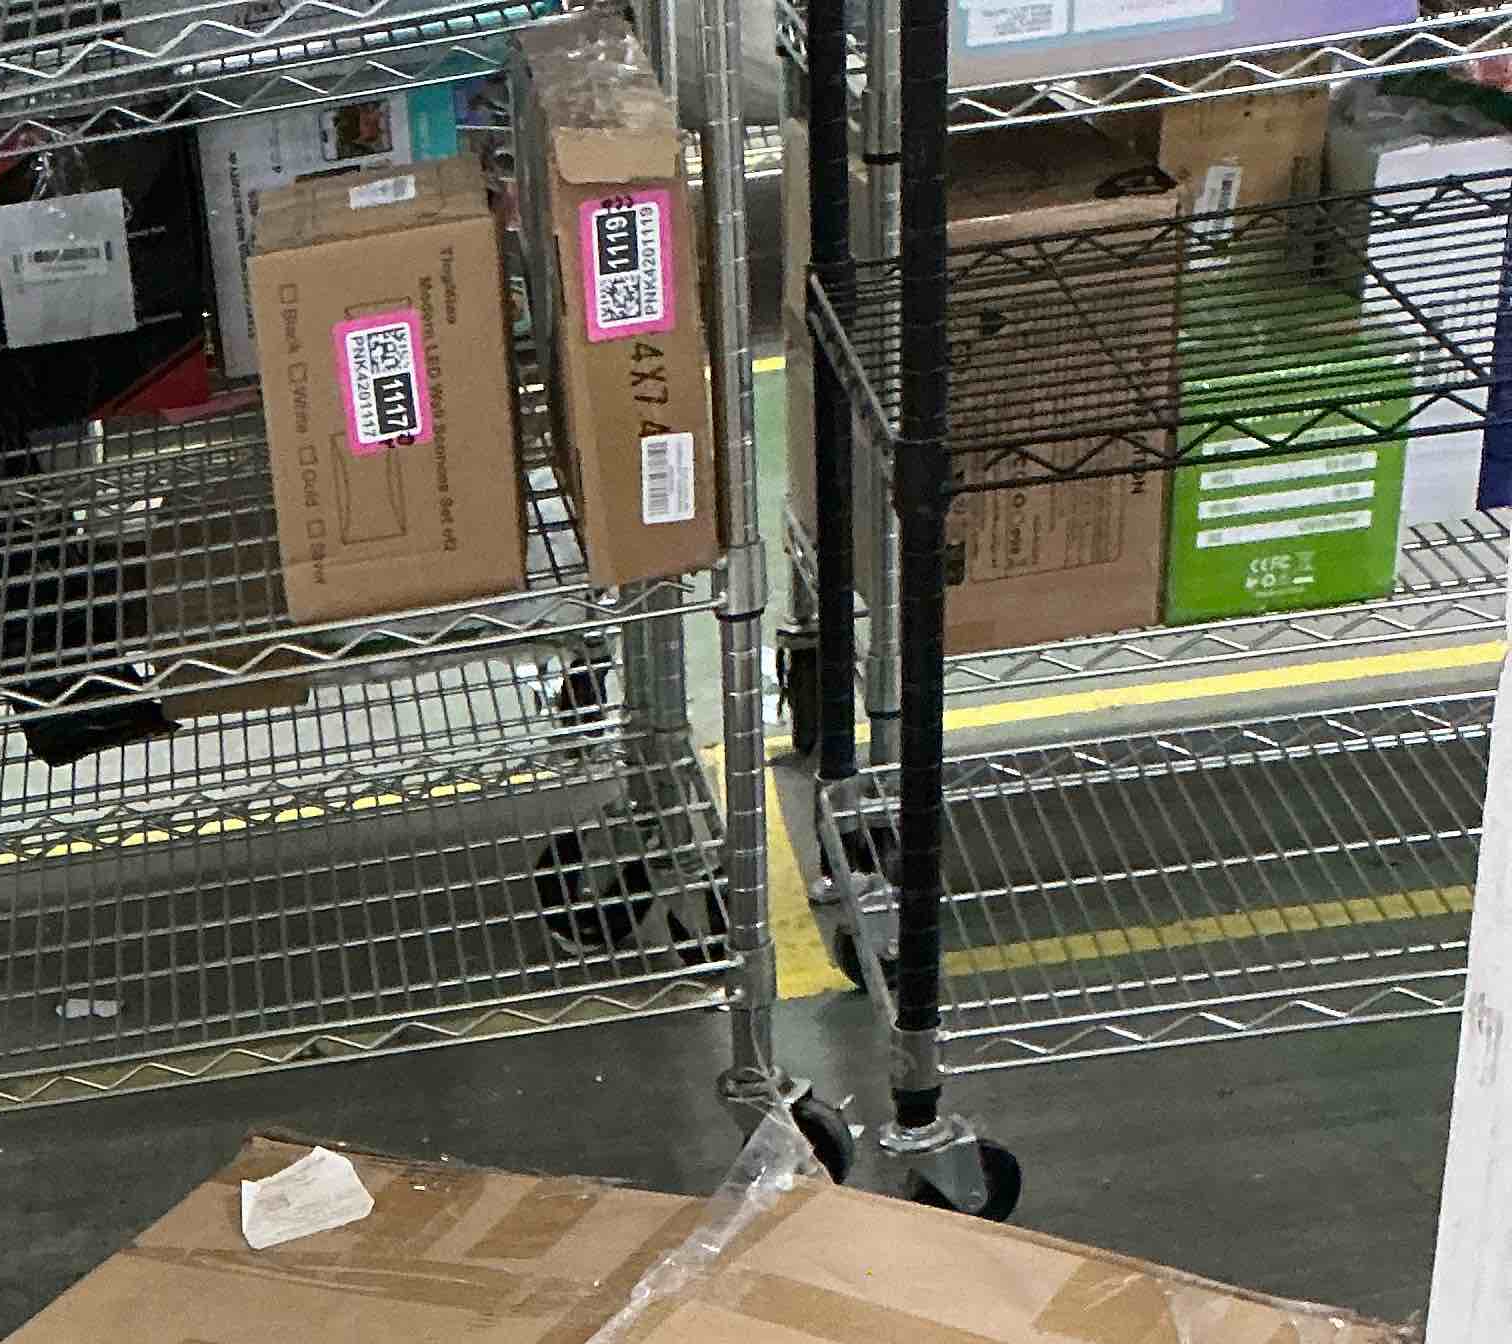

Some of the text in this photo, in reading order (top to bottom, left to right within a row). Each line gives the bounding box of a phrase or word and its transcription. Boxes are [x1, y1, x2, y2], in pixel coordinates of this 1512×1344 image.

[604, 215, 631, 270] 1119
[350, 335, 377, 438] PNK4201117
[381, 379, 409, 428] 1117
